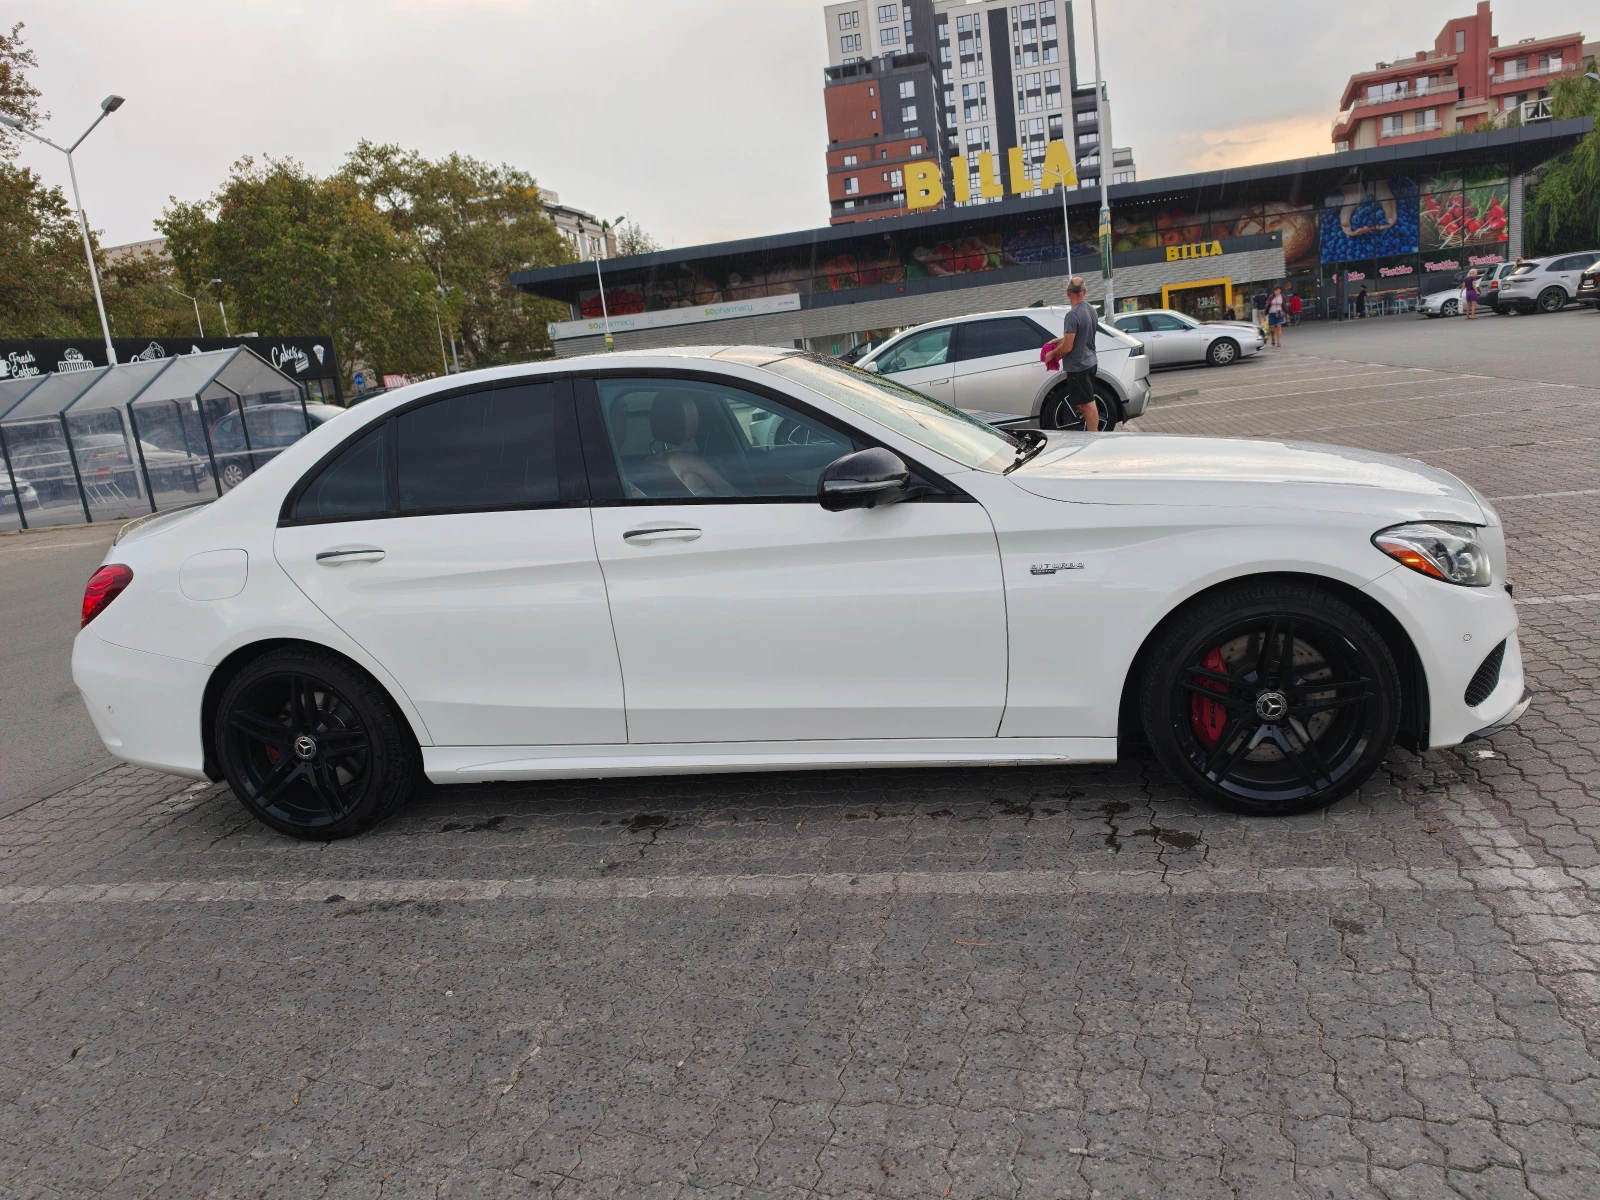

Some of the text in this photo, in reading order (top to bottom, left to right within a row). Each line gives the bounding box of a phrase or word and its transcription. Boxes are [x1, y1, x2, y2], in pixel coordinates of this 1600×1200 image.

[904, 139, 1078, 210] BILLA
[1166, 240, 1223, 262] BILLA
[704, 303, 753, 316] sopharmacy
[9, 350, 36, 364] Fresh
[271, 343, 298, 369] Cakes
[11, 363, 40, 378] Coffee
